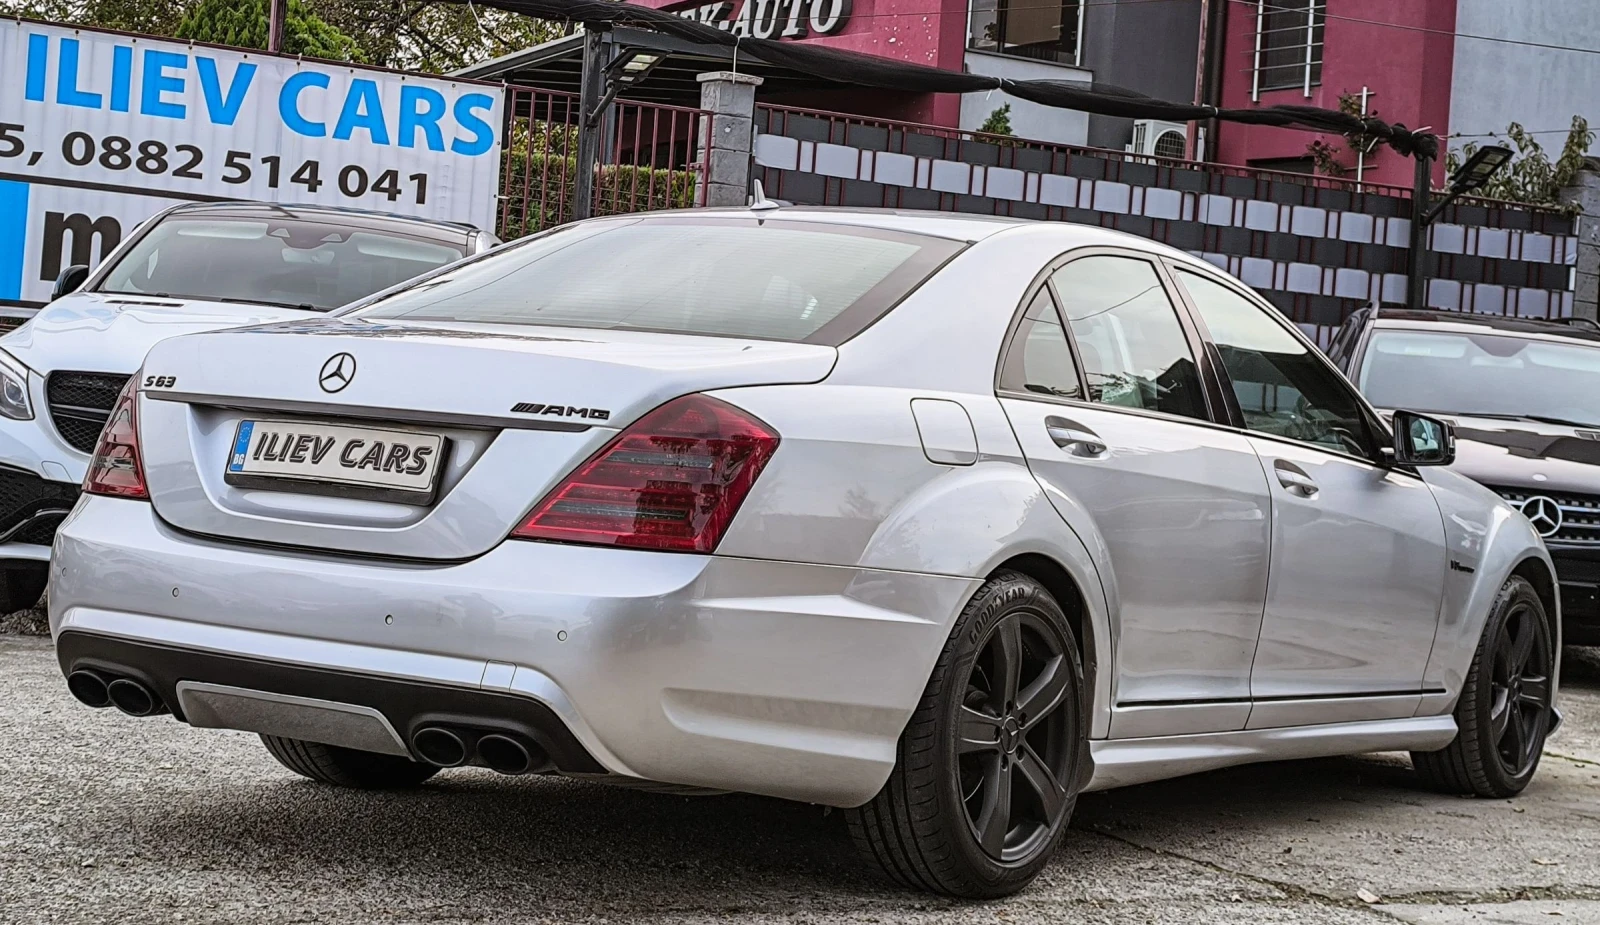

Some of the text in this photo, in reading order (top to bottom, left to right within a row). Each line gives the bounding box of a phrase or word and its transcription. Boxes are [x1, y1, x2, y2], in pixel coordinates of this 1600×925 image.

[24, 33, 495, 157] ILIEV CARS
[61, 130, 204, 180] 0882
[221, 150, 323, 193] 514
[338, 164, 428, 205] 041
[40, 211, 144, 282] m
[541, 404, 610, 420] AMG
[233, 453, 244, 465] BG
[252, 431, 433, 476] ILIEV CARS
